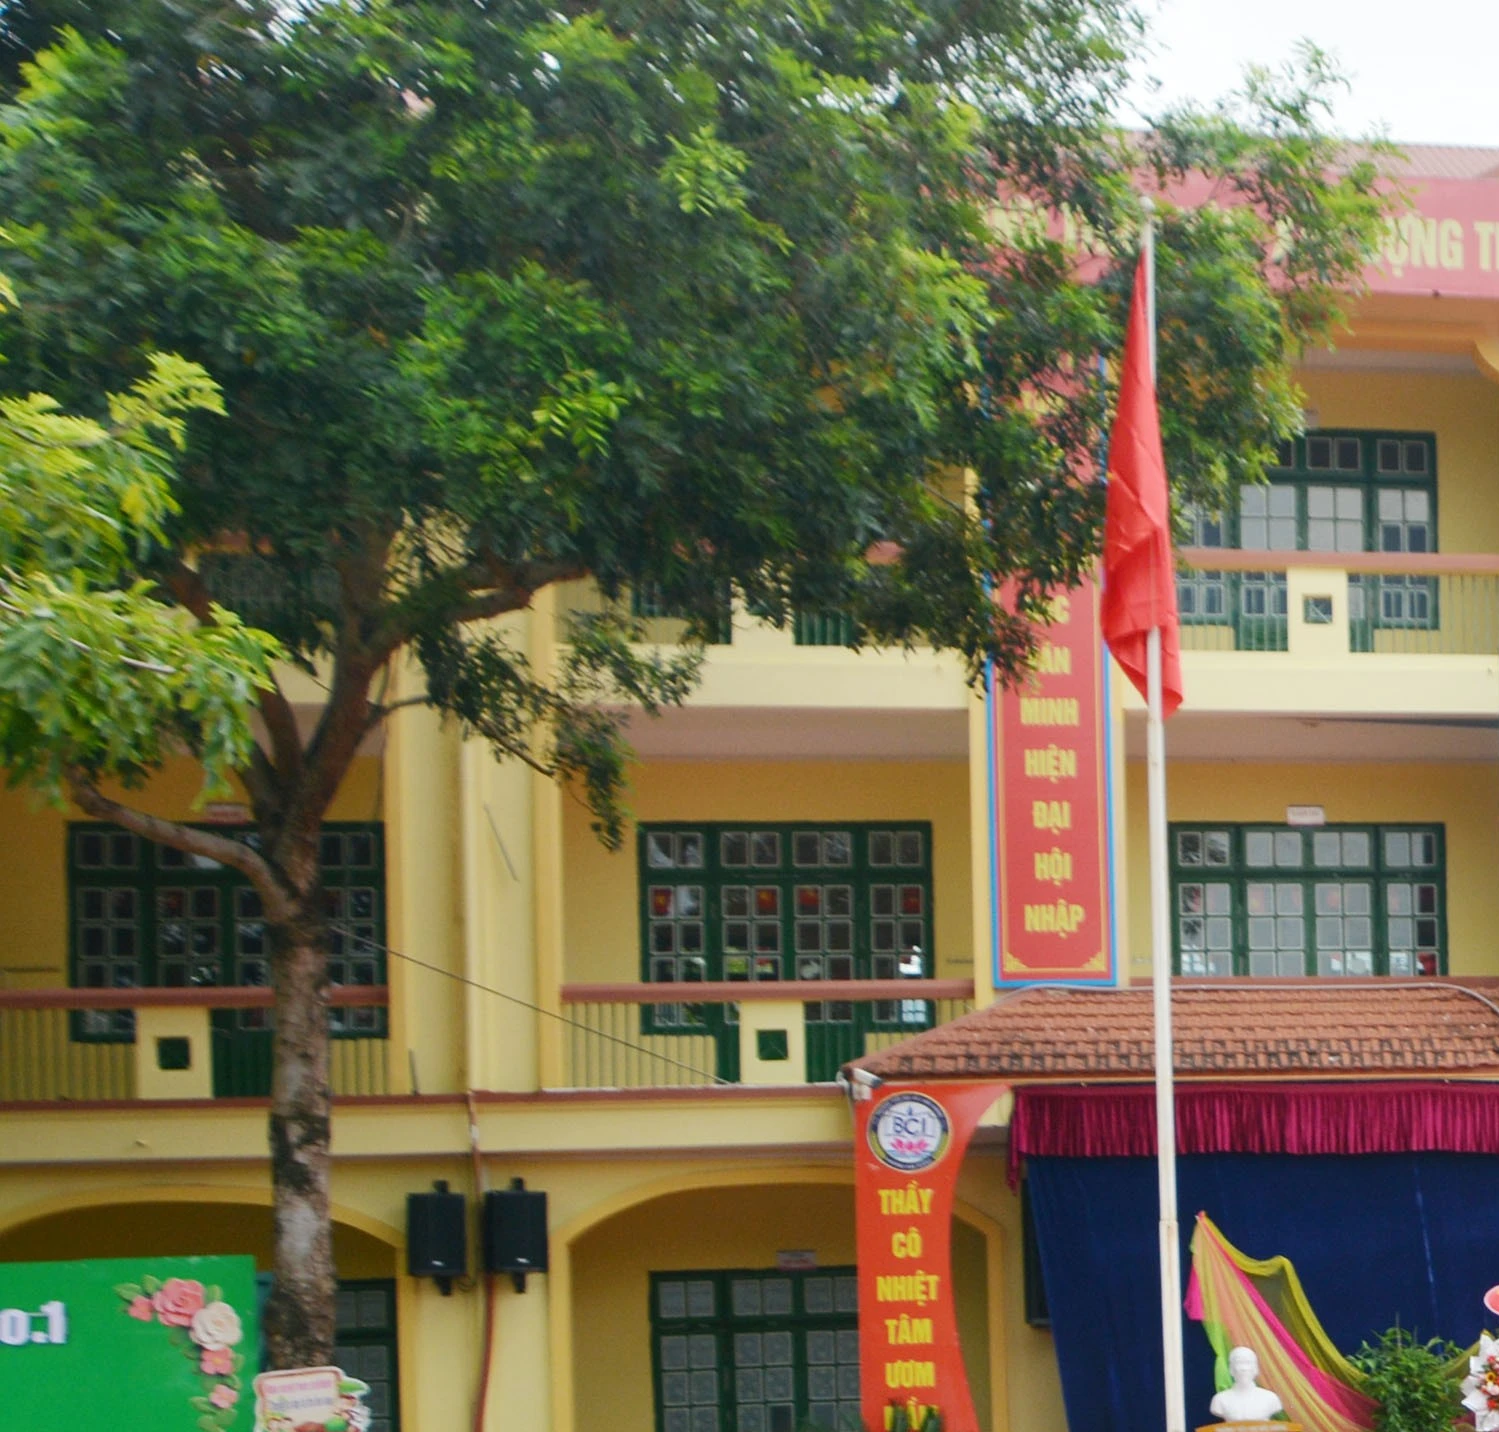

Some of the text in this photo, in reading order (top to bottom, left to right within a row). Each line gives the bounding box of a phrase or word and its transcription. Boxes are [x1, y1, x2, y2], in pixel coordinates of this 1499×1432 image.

[1362, 209, 1463, 277] ỰNG
[1020, 697, 1079, 726] MINH
[1024, 744, 1077, 783] HIỆN
[1032, 800, 1071, 835] ĐẠI
[1034, 847, 1073, 886] HỘI
[1024, 899, 1085, 938] NHẬP
[879, 1180, 933, 1215] THẦY
[891, 1227, 922, 1258] CÔ
[876, 1270, 940, 1307] NHIỆT
[885, 1313, 933, 1344] TÂM
[885, 1360, 935, 1388] ƯƠM
